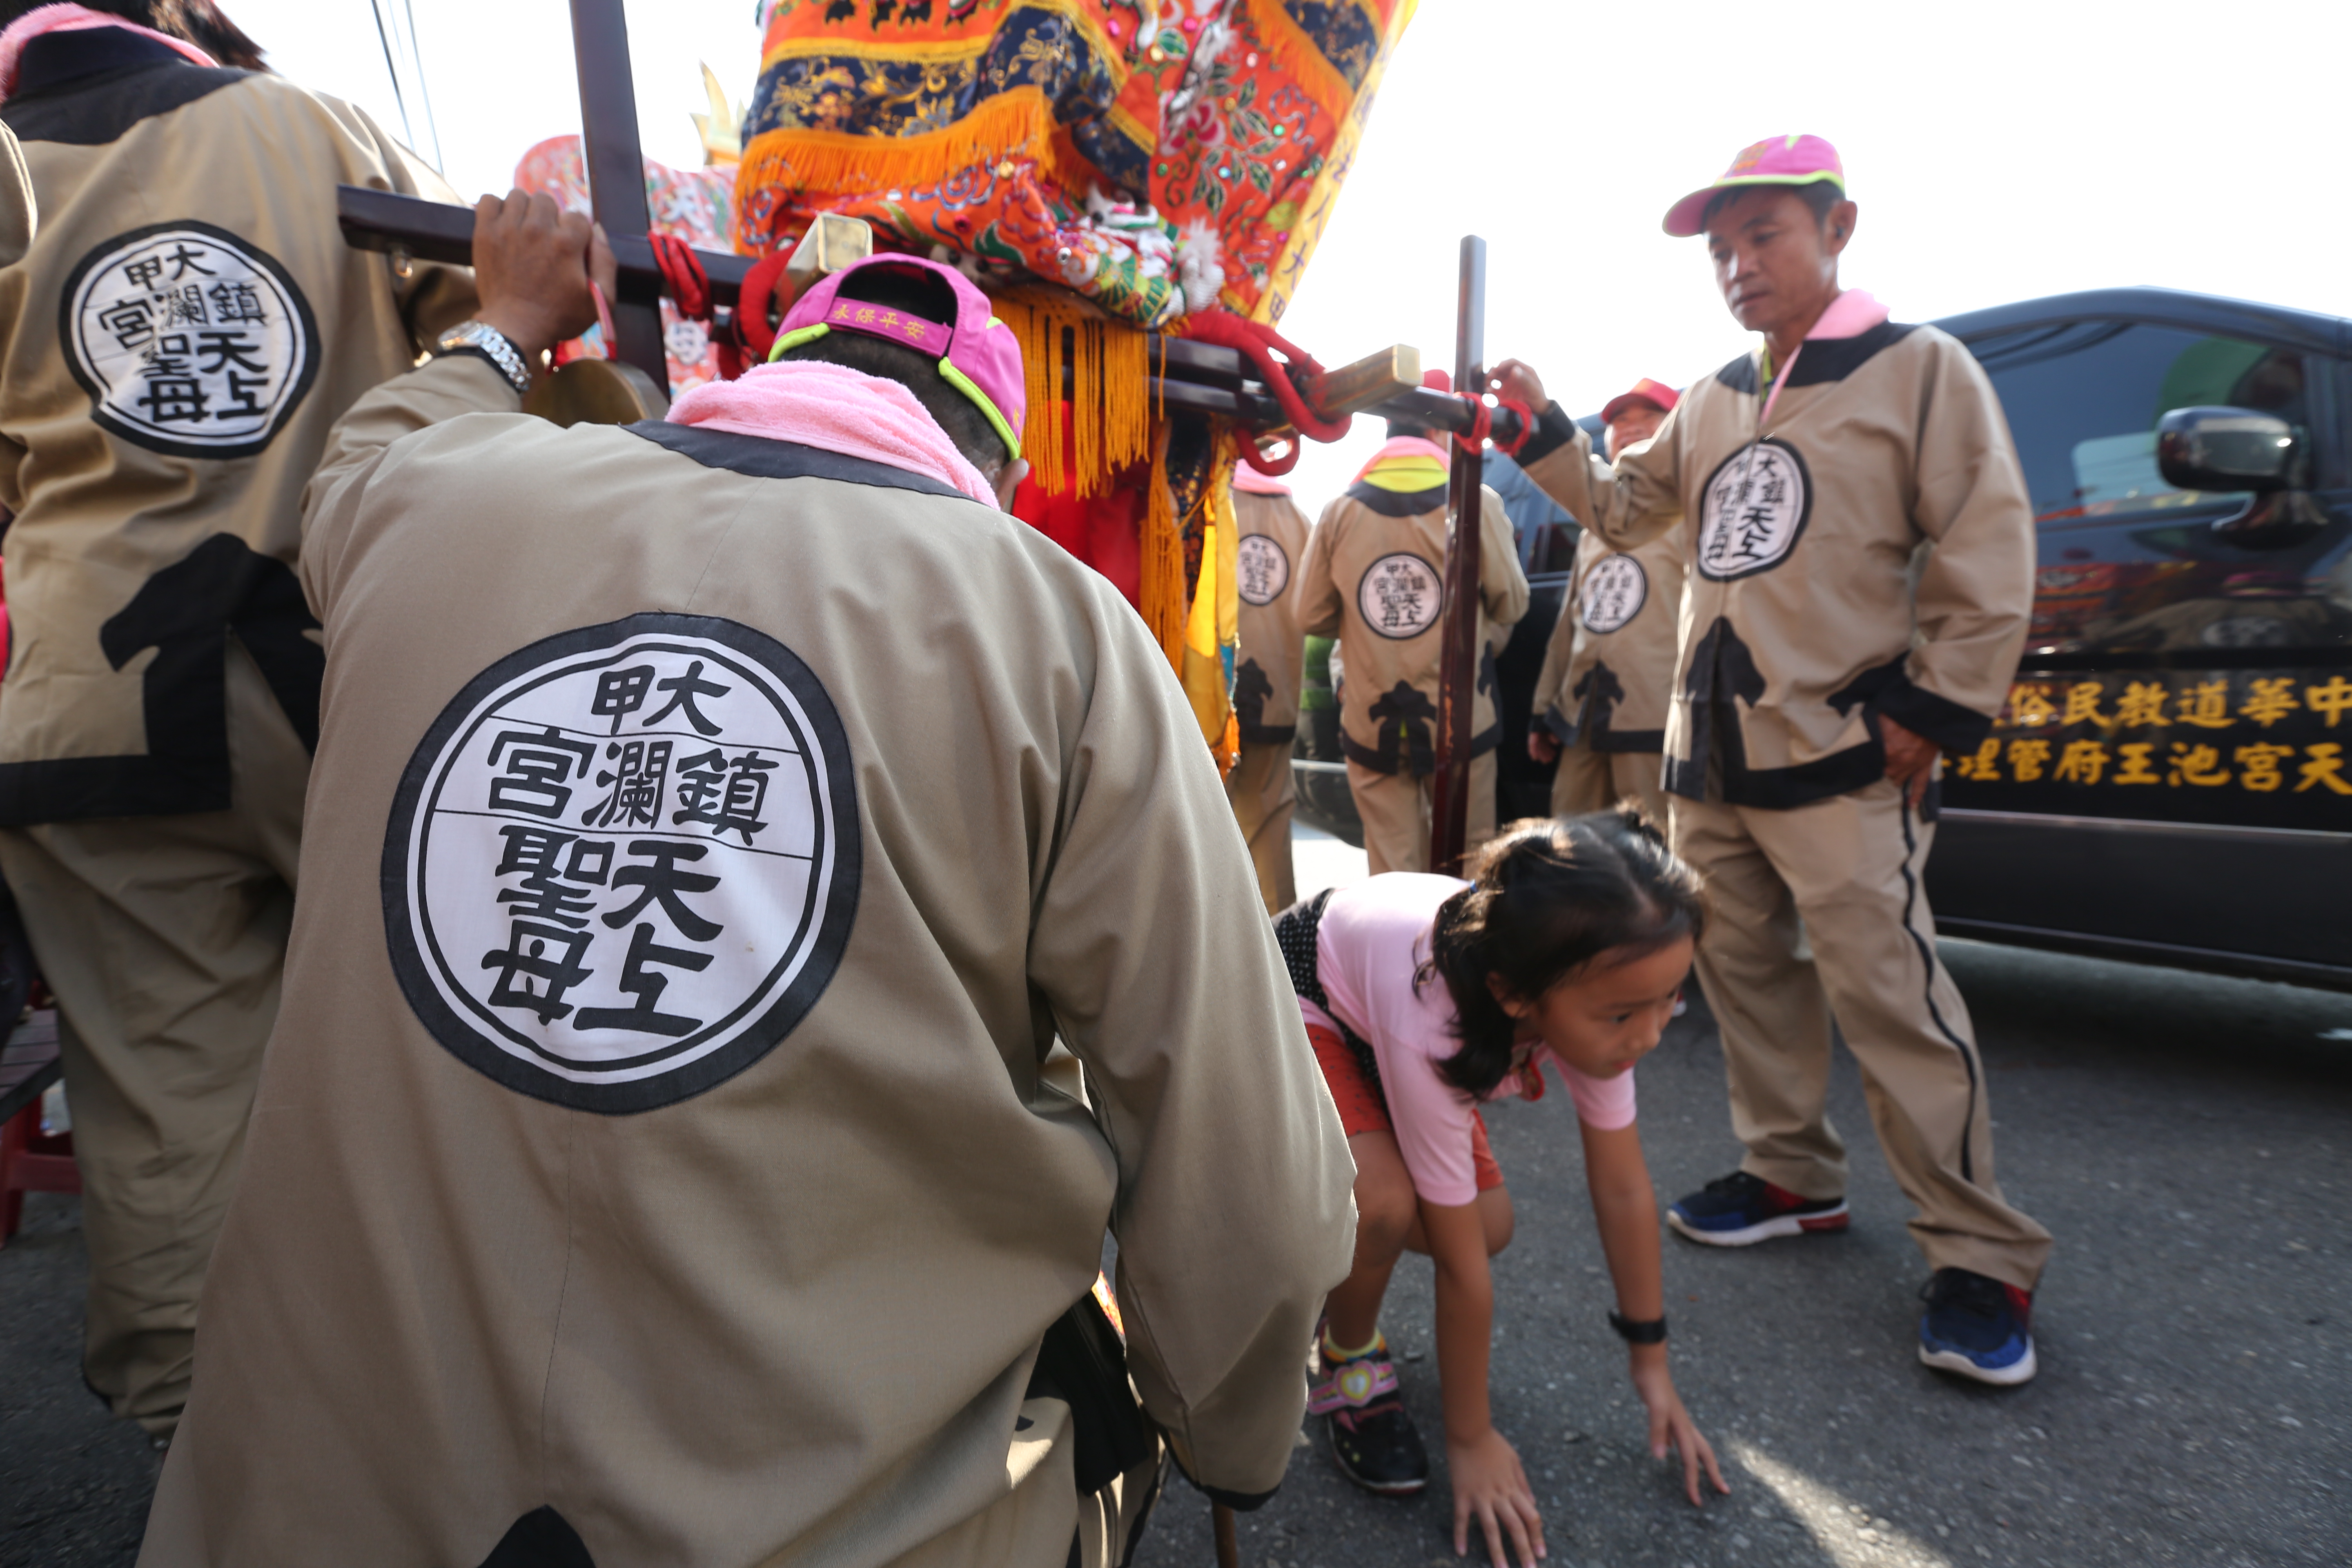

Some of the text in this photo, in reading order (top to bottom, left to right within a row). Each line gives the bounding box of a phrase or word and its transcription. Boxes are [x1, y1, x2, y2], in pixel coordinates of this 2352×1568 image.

[122, 244, 218, 292] 大甲
[833, 304, 925, 340] 永保平安
[591, 660, 732, 735] 大甲
[1993, 675, 2352, 728] 中華道教民俗
[487, 726, 780, 846] 鎮瀾宮
[1941, 737, 2352, 795] 天宮池王府管理
[480, 824, 615, 1025] 聖母
[572, 840, 724, 1038] 天上
